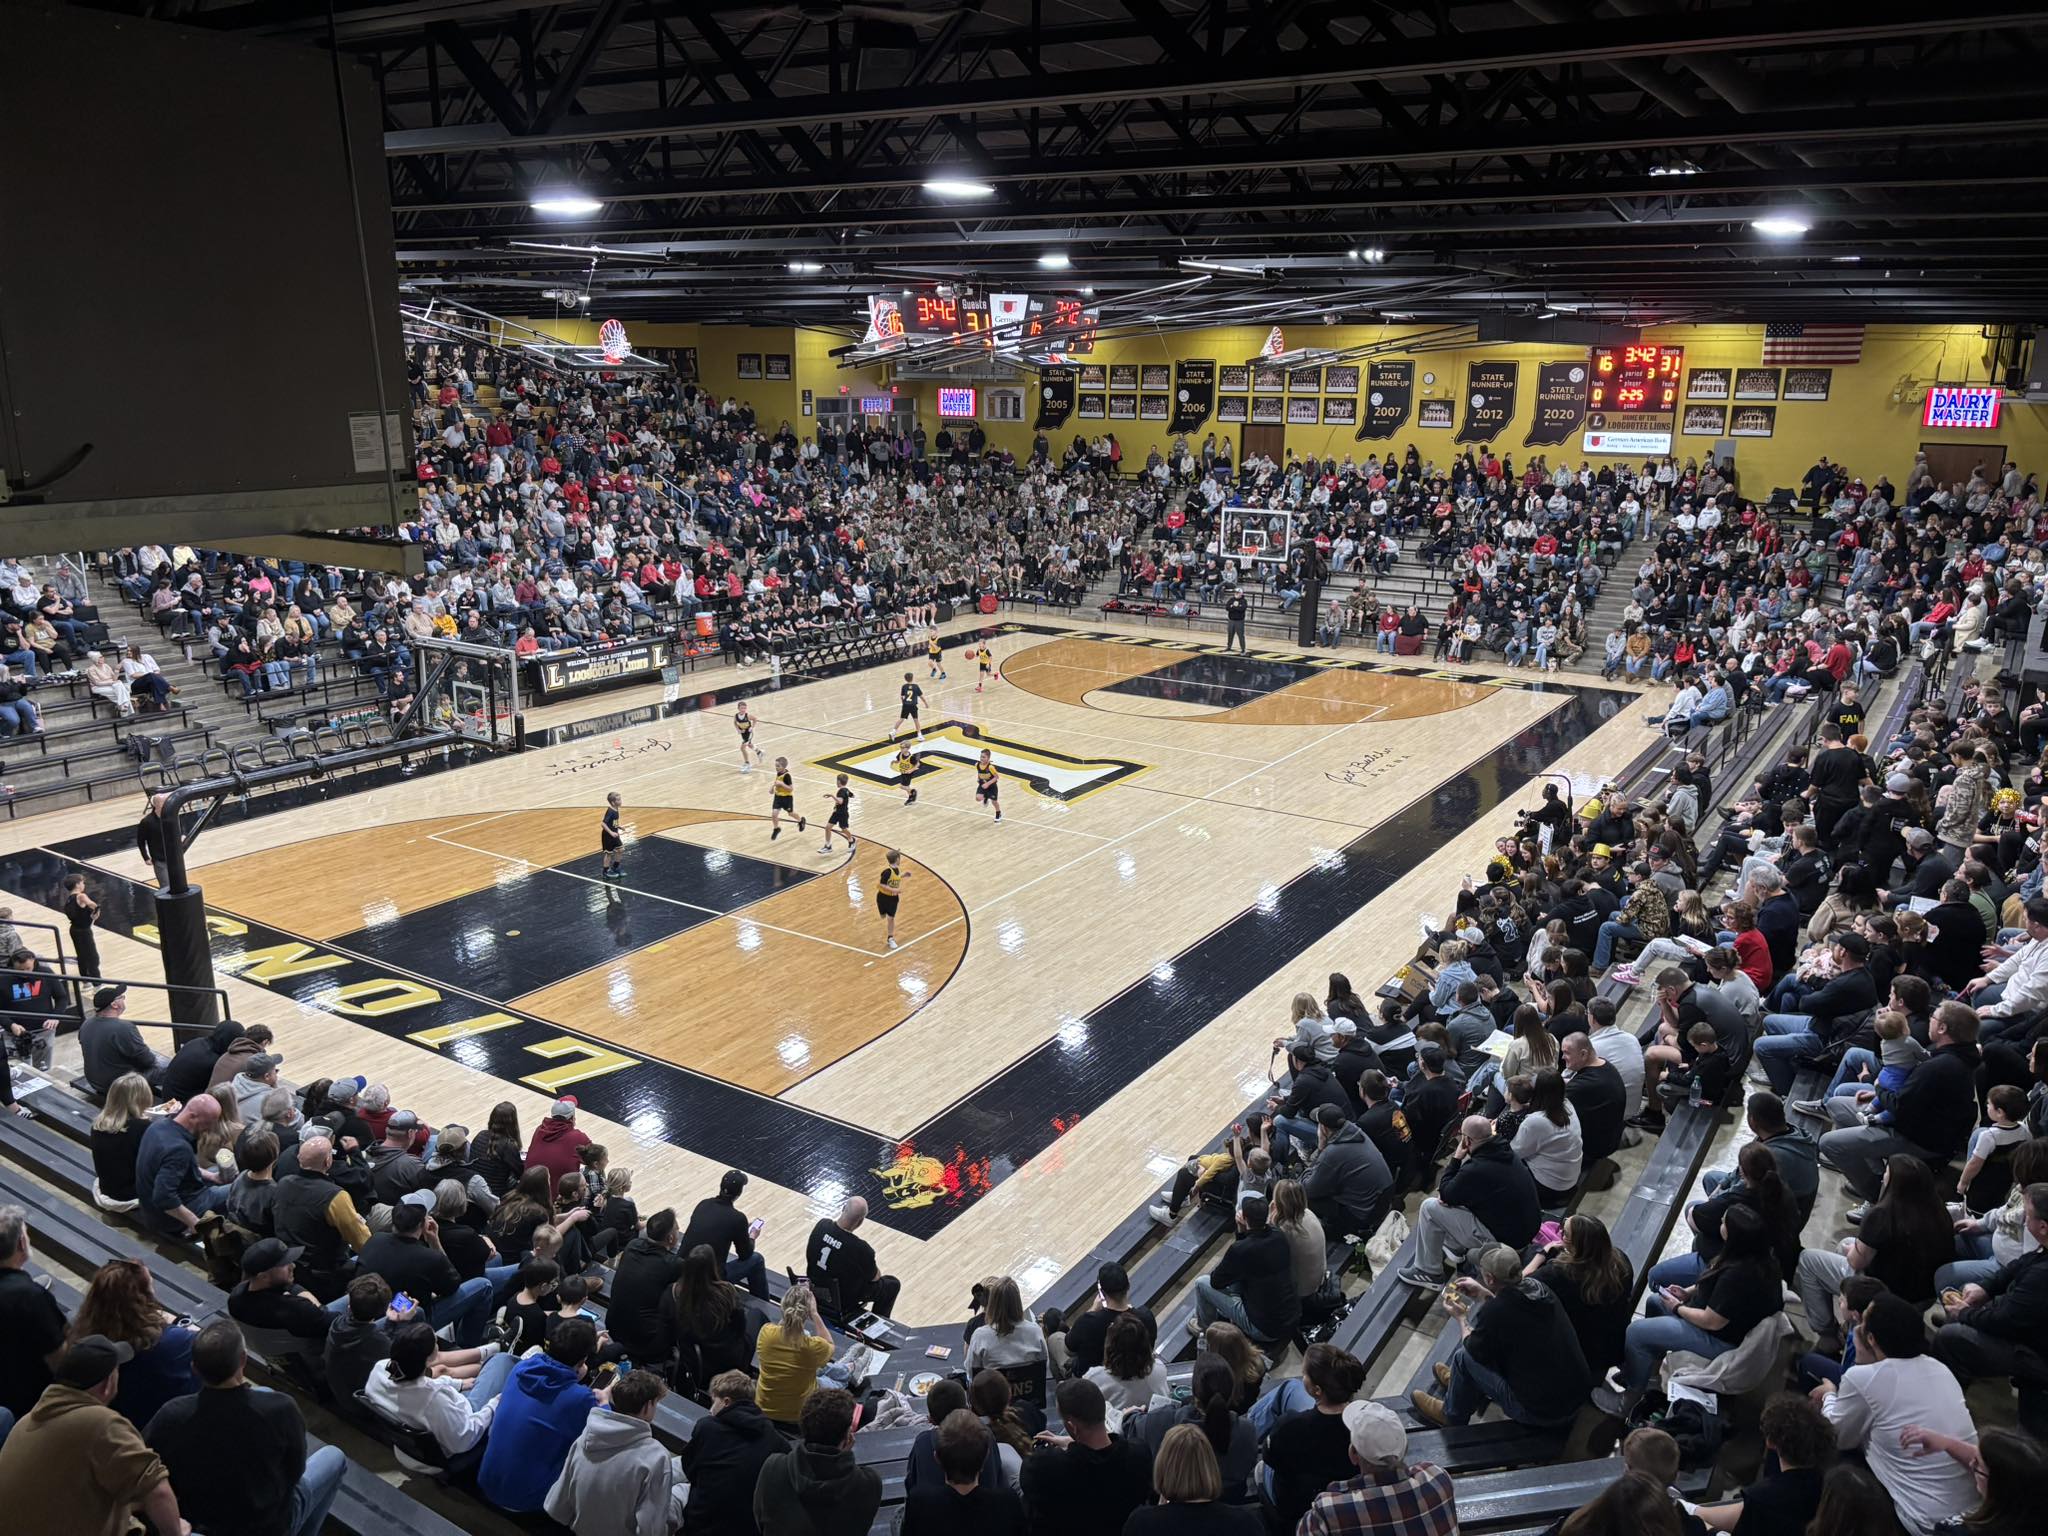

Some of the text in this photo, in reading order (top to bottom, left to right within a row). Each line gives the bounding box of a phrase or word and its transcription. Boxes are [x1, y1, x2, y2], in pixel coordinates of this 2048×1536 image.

[918, 298, 956, 320] 3:42
[962, 299, 987, 310] Guests
[1626, 347, 1656, 362] 3:42
[1600, 356, 1613, 371] 16
[1660, 356, 1680, 372] 31
[1648, 368, 1655, 379] 3
[942, 393, 970, 403] DAIRY
[1594, 389, 1602, 400] 0
[1664, 390, 1673, 401] 0
[1046, 400, 1068, 409] 2005
[1934, 394, 1992, 409] DAIRY
[942, 404, 970, 412] MASTER
[1182, 403, 1205, 413] 2006
[1374, 407, 1401, 417] 2007
[1476, 410, 1503, 419] 2012
[1544, 409, 1574, 419] 2020
[1932, 409, 1989, 420] MASTER
[1592, 415, 1602, 426] L
[1649, 422, 1671, 430] LIONS
[653, 645, 669, 670] L
[547, 663, 566, 690] L
[906, 690, 913, 701] 2
[822, 1234, 842, 1250] SIMS
[816, 1246, 832, 1271] 1
